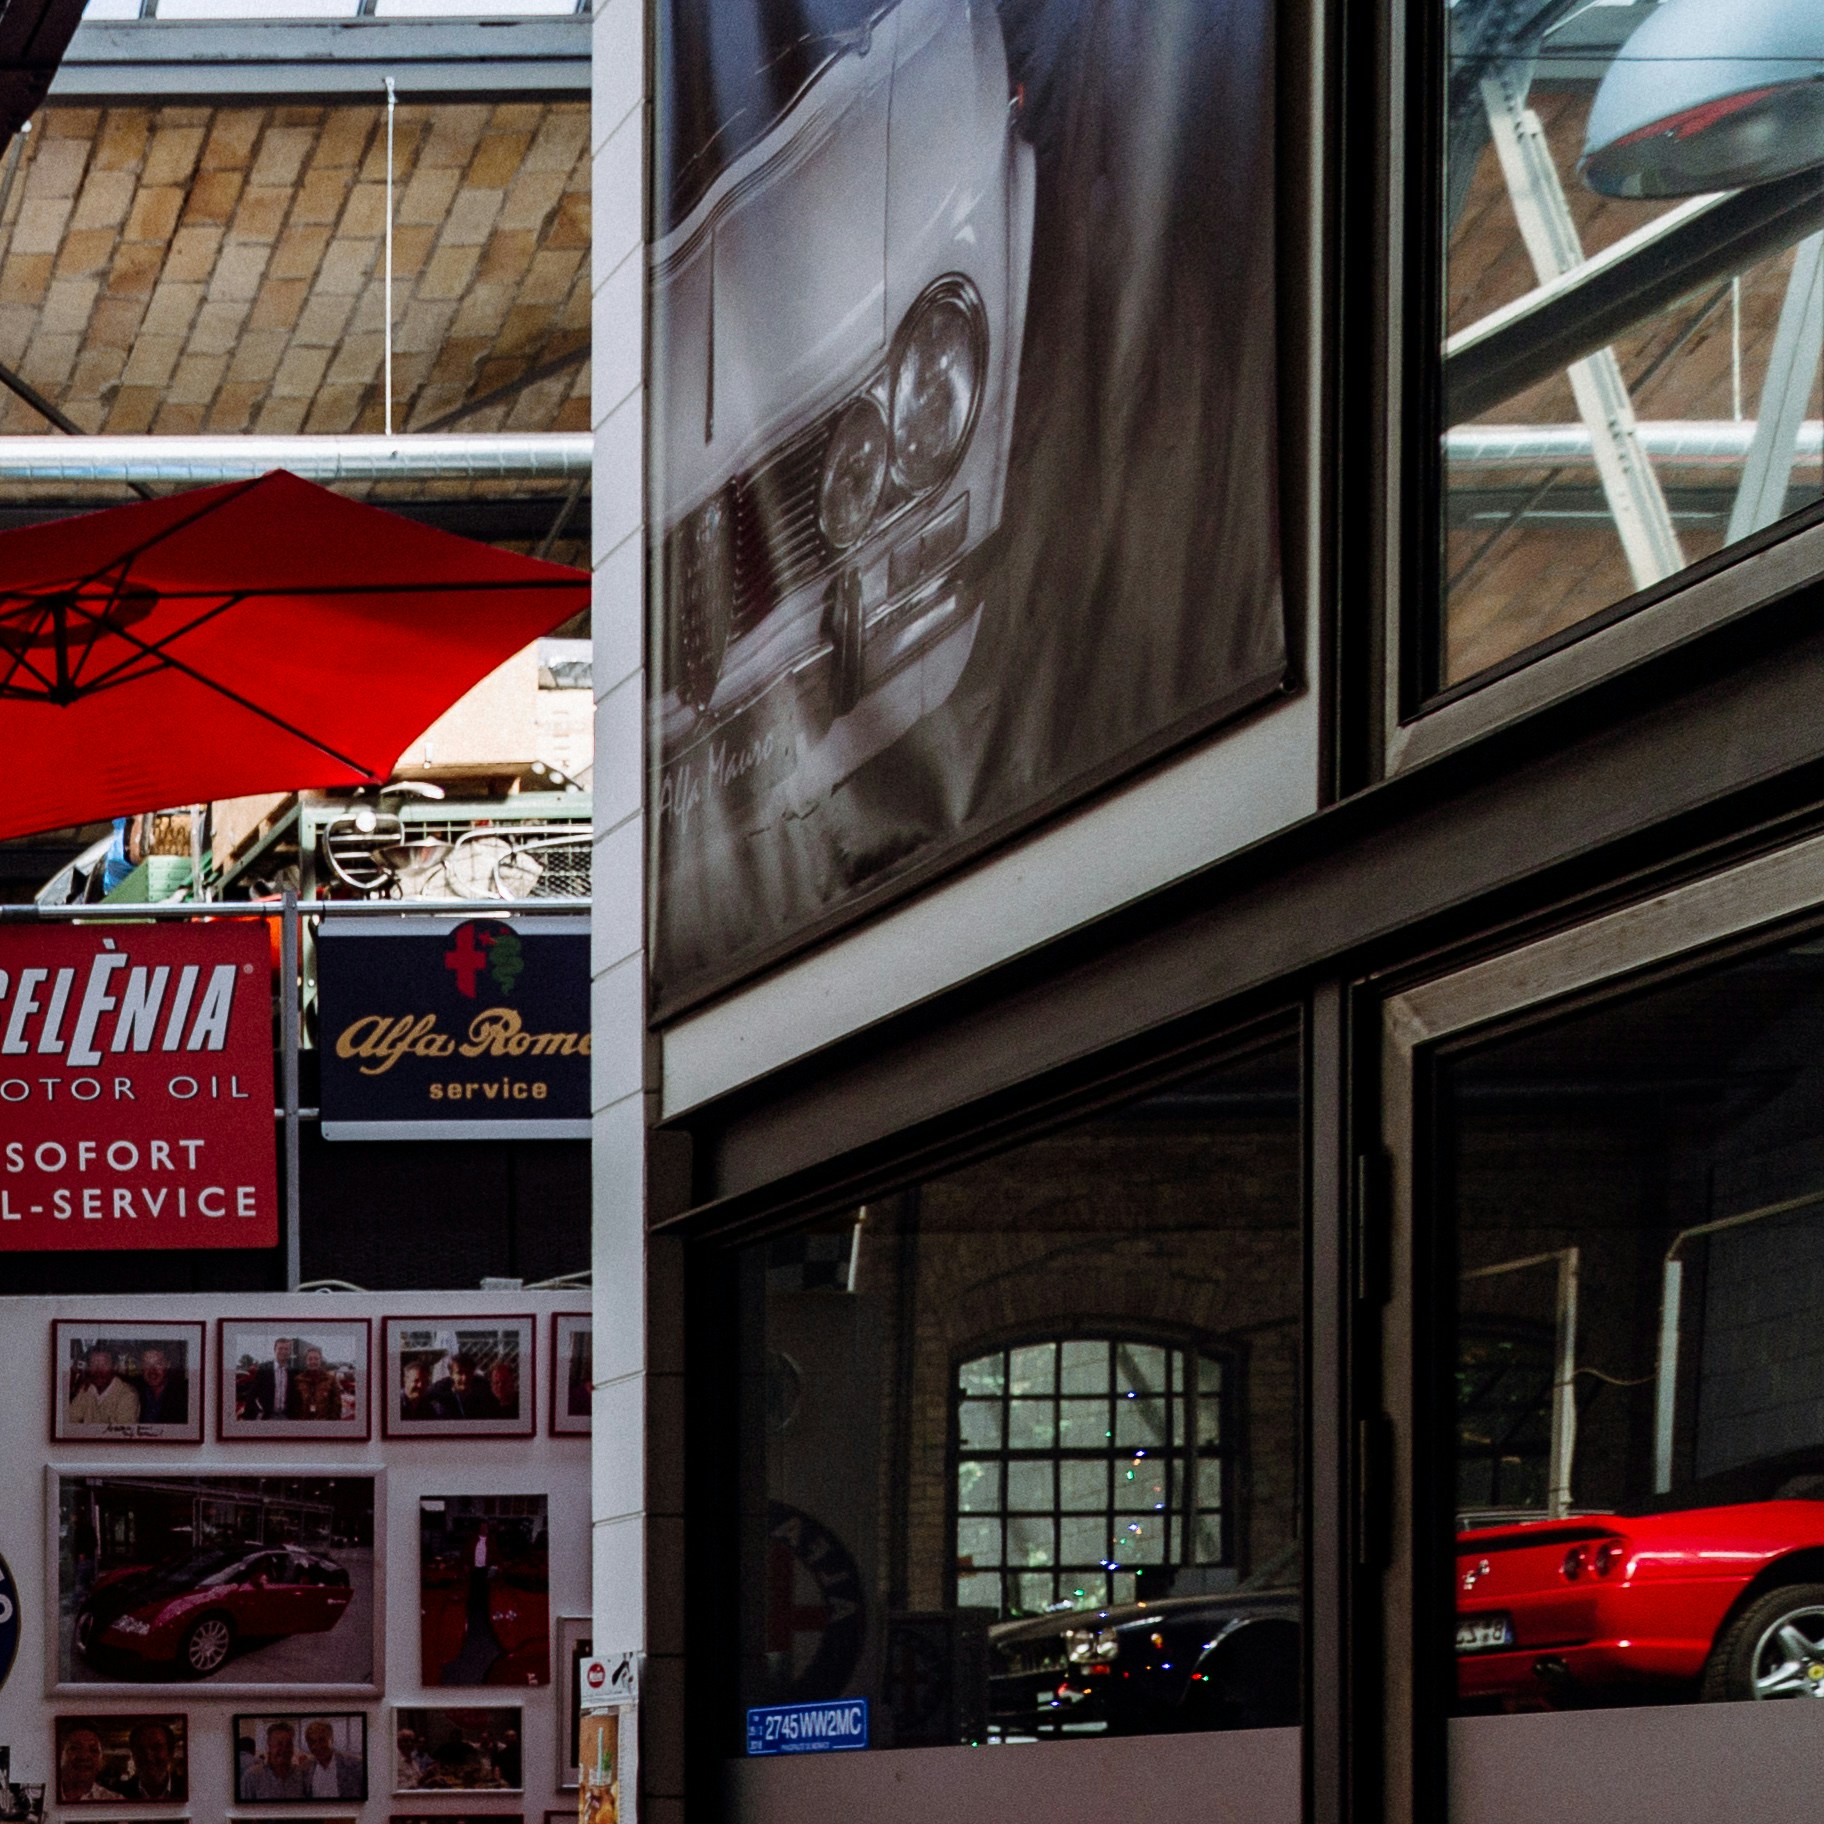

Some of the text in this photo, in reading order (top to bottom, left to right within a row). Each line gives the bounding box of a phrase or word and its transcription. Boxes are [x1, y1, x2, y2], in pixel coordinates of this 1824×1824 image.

[336, 1013, 456, 1076] Alfa
[168, 1075, 250, 1099] OIL
[429, 1077, 548, 1100] service
[5, 1139, 205, 1173] SOFORT
